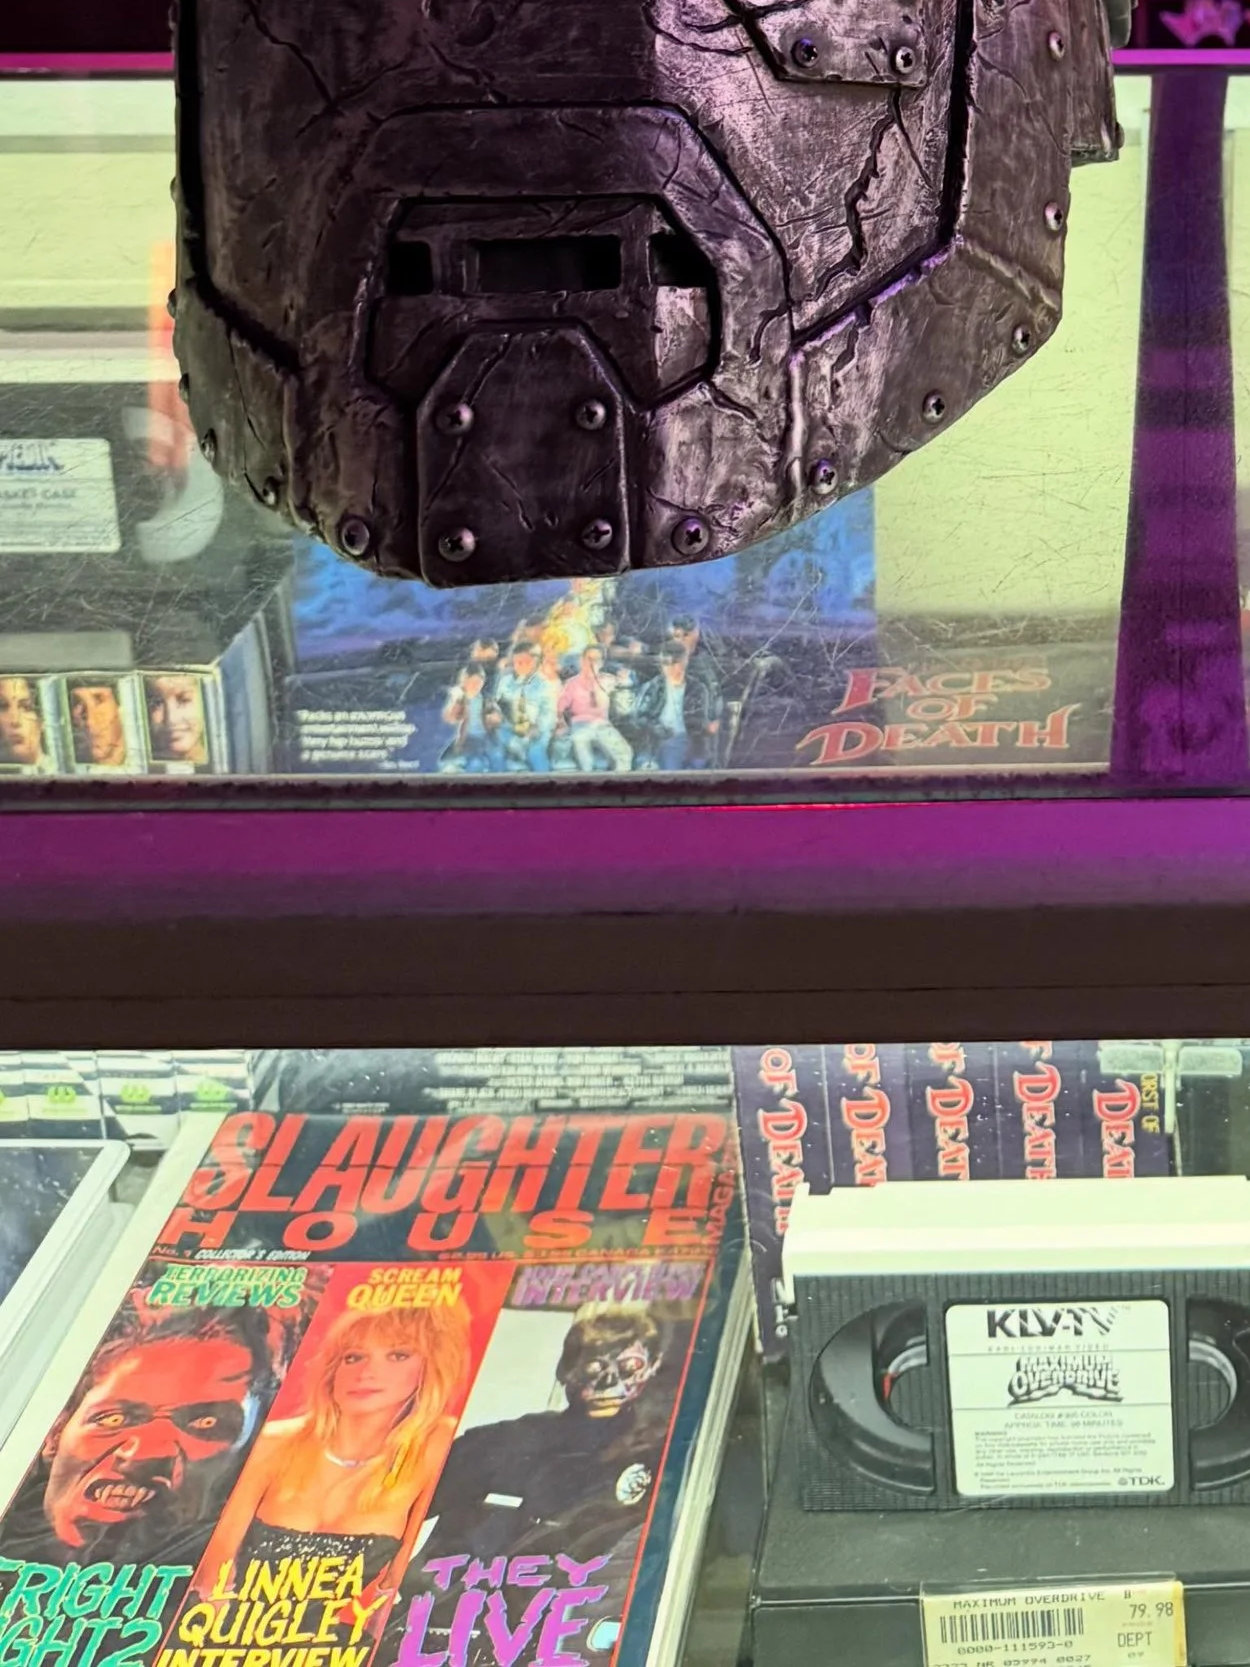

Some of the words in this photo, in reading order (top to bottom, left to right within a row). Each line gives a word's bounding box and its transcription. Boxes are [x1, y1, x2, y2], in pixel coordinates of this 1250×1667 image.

[831, 665, 1052, 715] FACES
[906, 694, 998, 721] OF
[796, 702, 1083, 766] DEATH
[759, 1047, 799, 1096] OF
[182, 1110, 733, 1214] SLAUGHTER
[155, 1209, 710, 1252] HOUSE
[164, 1264, 308, 1283] TERRORIZING
[368, 1267, 463, 1284] SCREAM
[146, 1280, 303, 1307] REVIEWS
[347, 1283, 464, 1308] QUEEN
[511, 1277, 702, 1306] INTERVIEW
[1016, 1354, 1114, 1375] MAXIMUM
[1008, 1369, 1121, 1400] OVERDRIVE
[211, 1554, 365, 1603] LINNEA
[422, 1553, 612, 1589] THEY
[953, 1596, 1017, 1610] MAXIMUM
[1024, 1590, 1105, 1606] OVERDRIVE
[1129, 1601, 1174, 1620] 79.98
[178, 1595, 387, 1646] QUIGLEY
[388, 1585, 608, 1667] LIVE
[0, 1615, 122, 1667] GHT
[1117, 1631, 1152, 1648] DEPT
[156, 1646, 369, 1667] INTERVIEW
